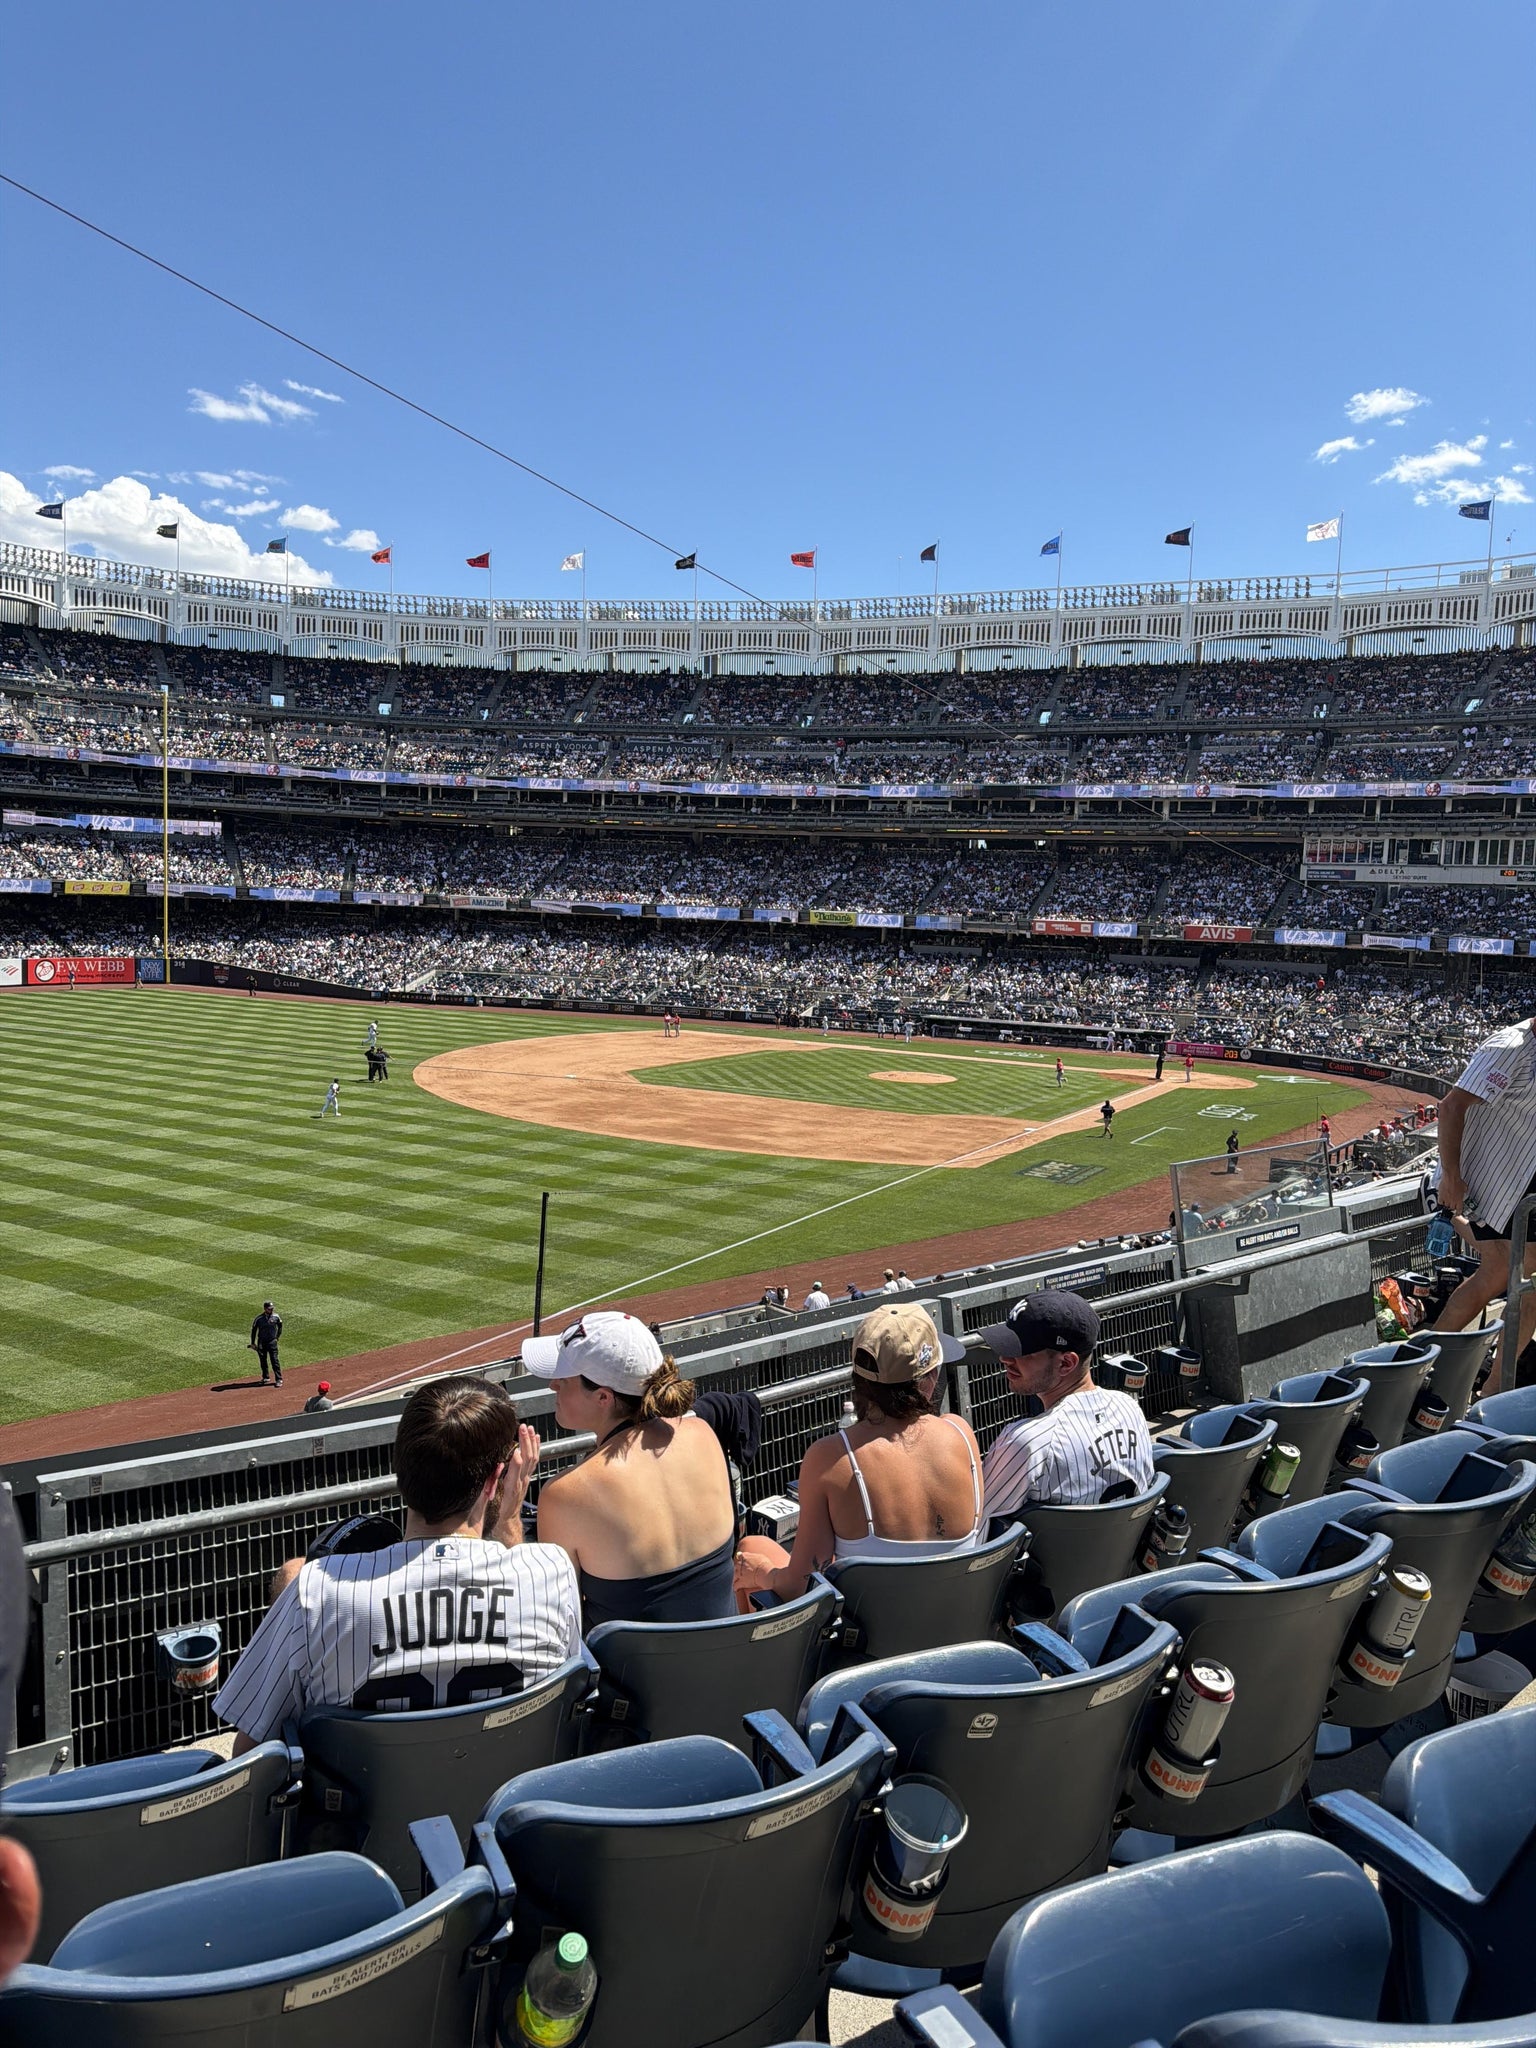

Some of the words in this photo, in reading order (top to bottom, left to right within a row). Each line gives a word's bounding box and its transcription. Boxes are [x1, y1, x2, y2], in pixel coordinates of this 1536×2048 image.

[522, 742, 551, 750] ASPEN
[633, 745, 663, 753] ASPEN
[675, 746, 705, 754] VODKA
[472, 898, 504, 907] AMAZING
[814, 911, 851, 922] Nathan's
[1200, 927, 1236, 939] AVIS
[56, 961, 80, 972] F.W.
[84, 961, 125, 971] WEBB
[1224, 1050, 1238, 1059] 203
[1328, 1061, 1354, 1072] Canon
[1364, 1067, 1386, 1078] Canon
[1088, 1429, 1137, 1476] JETER
[372, 1587, 514, 1658] JUDGE
[159, 1807, 180, 1818] BATS
[180, 1794, 211, 1812] AND/OR
[213, 1784, 235, 1800] BALLS
[173, 1800, 185, 1808] BE
[186, 1791, 208, 1804] ALERT
[209, 1784, 224, 1794] FOR
[795, 1799, 818, 1813] ALERT
[765, 1821, 786, 1830] BATS
[332, 1974, 347, 1985] BE
[350, 1957, 384, 1977] ALERT
[386, 1944, 407, 1960] FOR
[311, 1983, 341, 1999] BATS
[343, 1962, 388, 1988] AND/OR
[390, 1942, 422, 1965] BALLS
